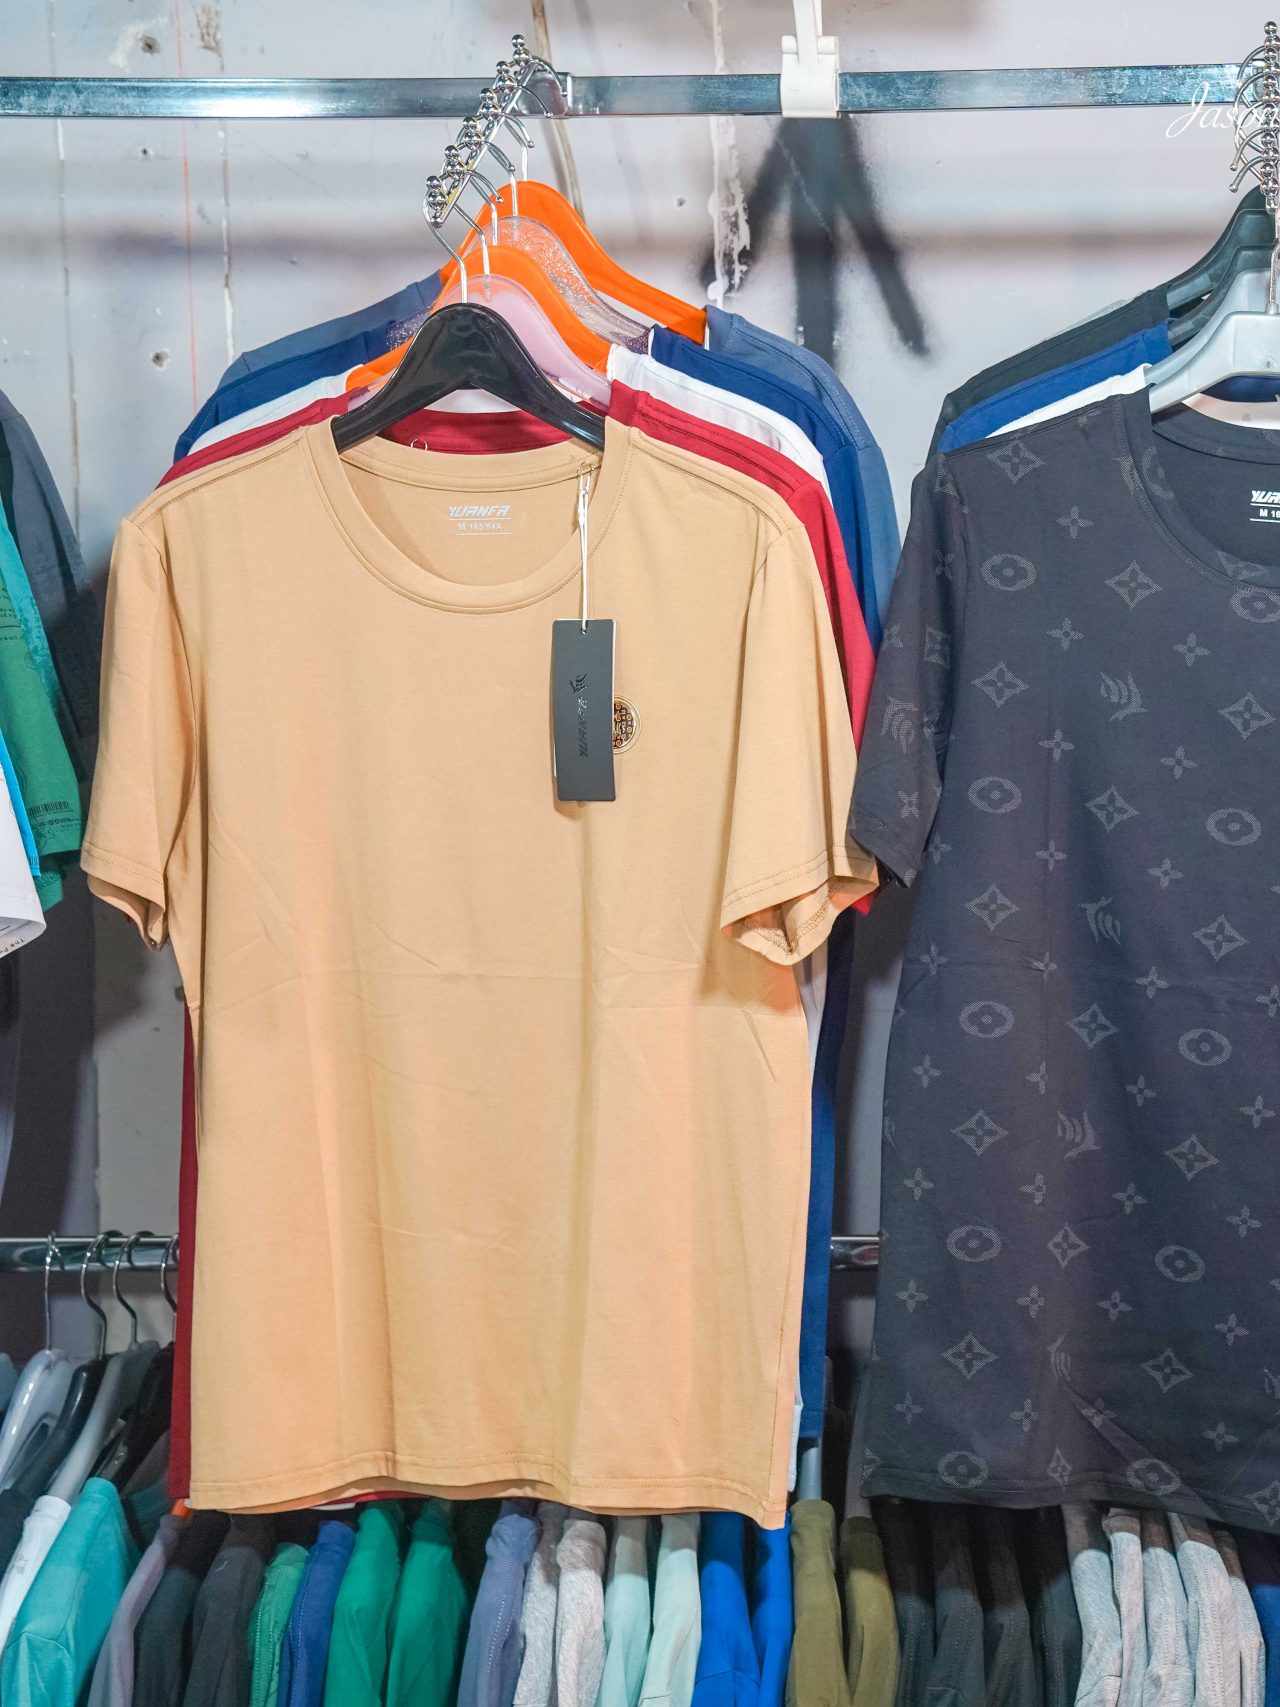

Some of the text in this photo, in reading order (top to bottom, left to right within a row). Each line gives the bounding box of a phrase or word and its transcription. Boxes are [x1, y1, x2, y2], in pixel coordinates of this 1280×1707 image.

[448, 505, 511, 518] YUANFA
[1259, 508, 1268, 517] M
[458, 523, 466, 531] M
